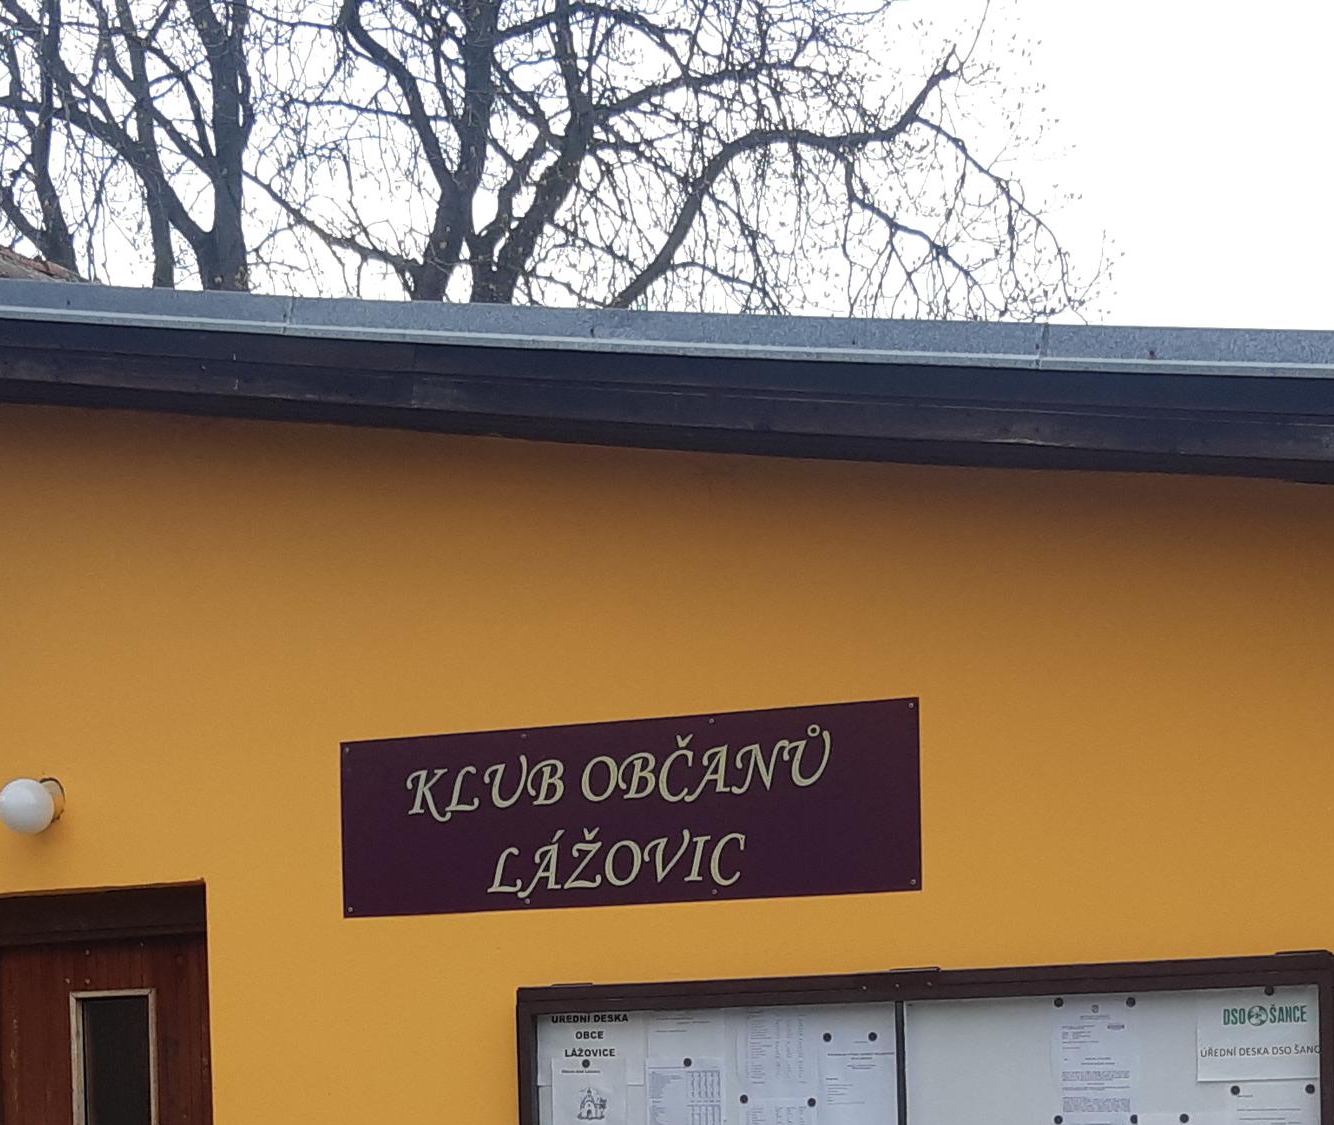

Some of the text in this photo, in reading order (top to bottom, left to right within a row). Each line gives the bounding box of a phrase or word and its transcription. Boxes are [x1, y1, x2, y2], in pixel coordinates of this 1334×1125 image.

[405, 723, 832, 822] KLUB OBČANŮ
[487, 827, 746, 898] LÁŽOVIC
[594, 1014, 628, 1022] DESKA
[1222, 1004, 1308, 1026] DSO ŠANCE
[576, 1031, 603, 1039] OBCE
[565, 1048, 615, 1057] LÁŽOVICE
[1200, 1044, 1321, 1058] ÚŘEDNÍ DESKA DSO ŠANC
